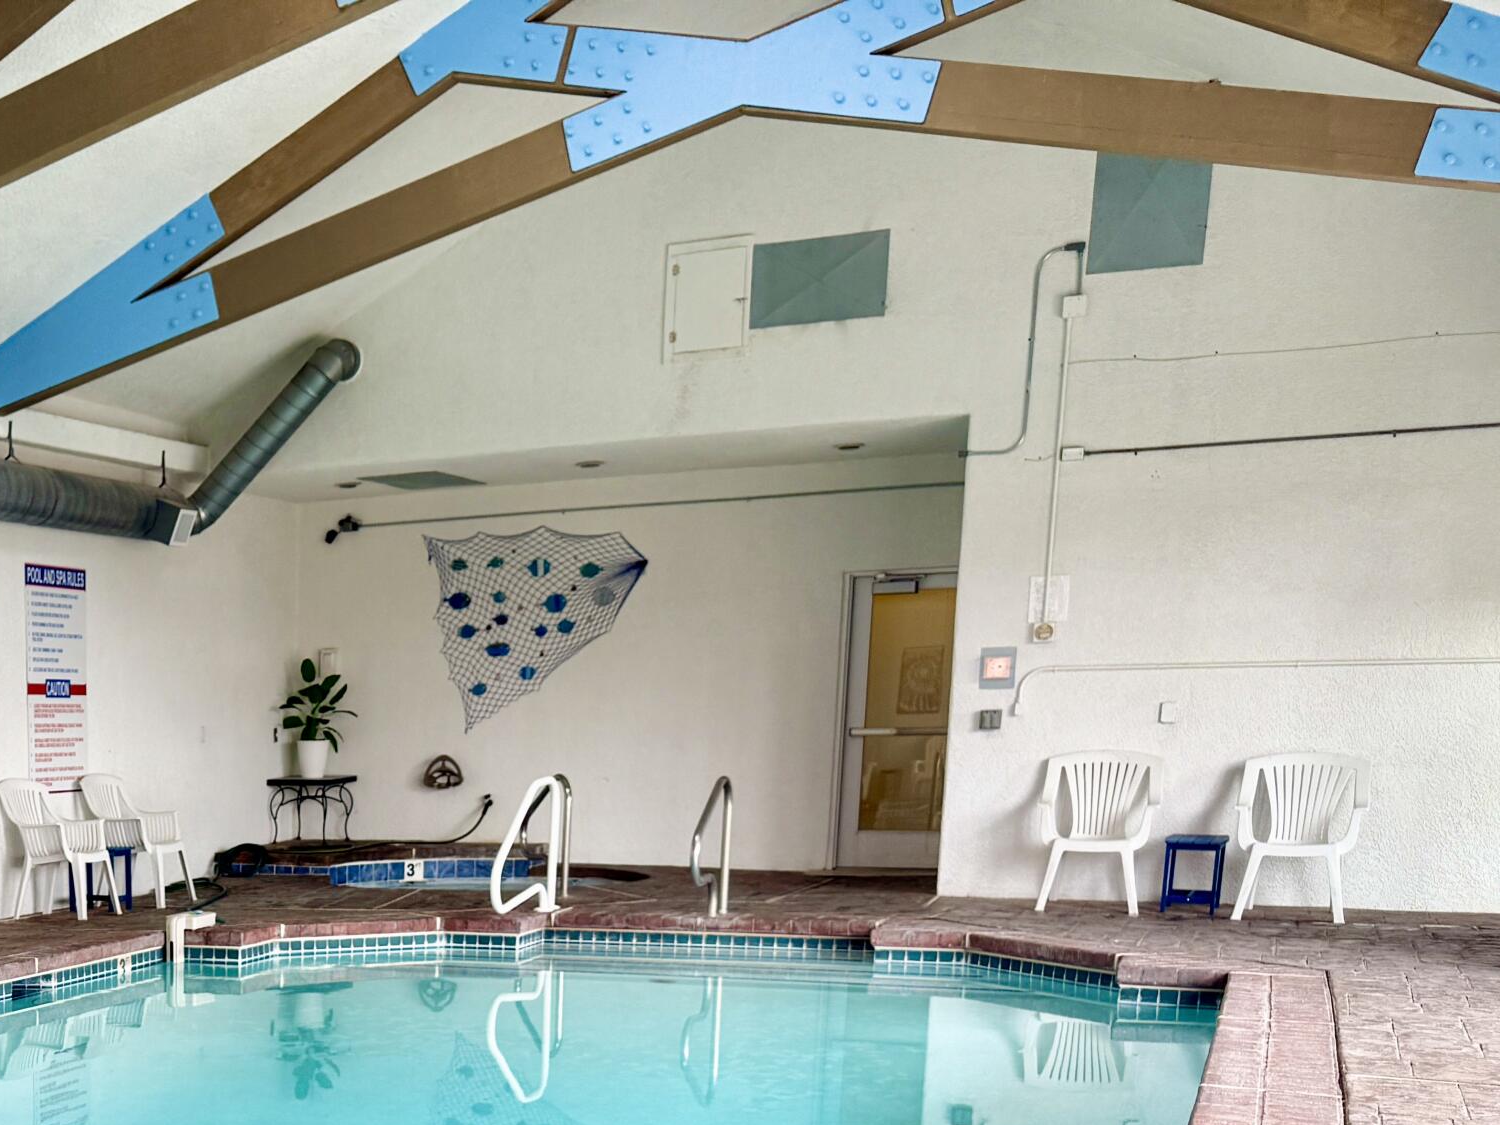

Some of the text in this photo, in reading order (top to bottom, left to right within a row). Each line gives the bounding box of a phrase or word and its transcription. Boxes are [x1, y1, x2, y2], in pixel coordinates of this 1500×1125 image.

[27, 566, 84, 588] POOL AND SPA RULES
[46, 682, 70, 696] CAUTION
[407, 863, 415, 876] 3
